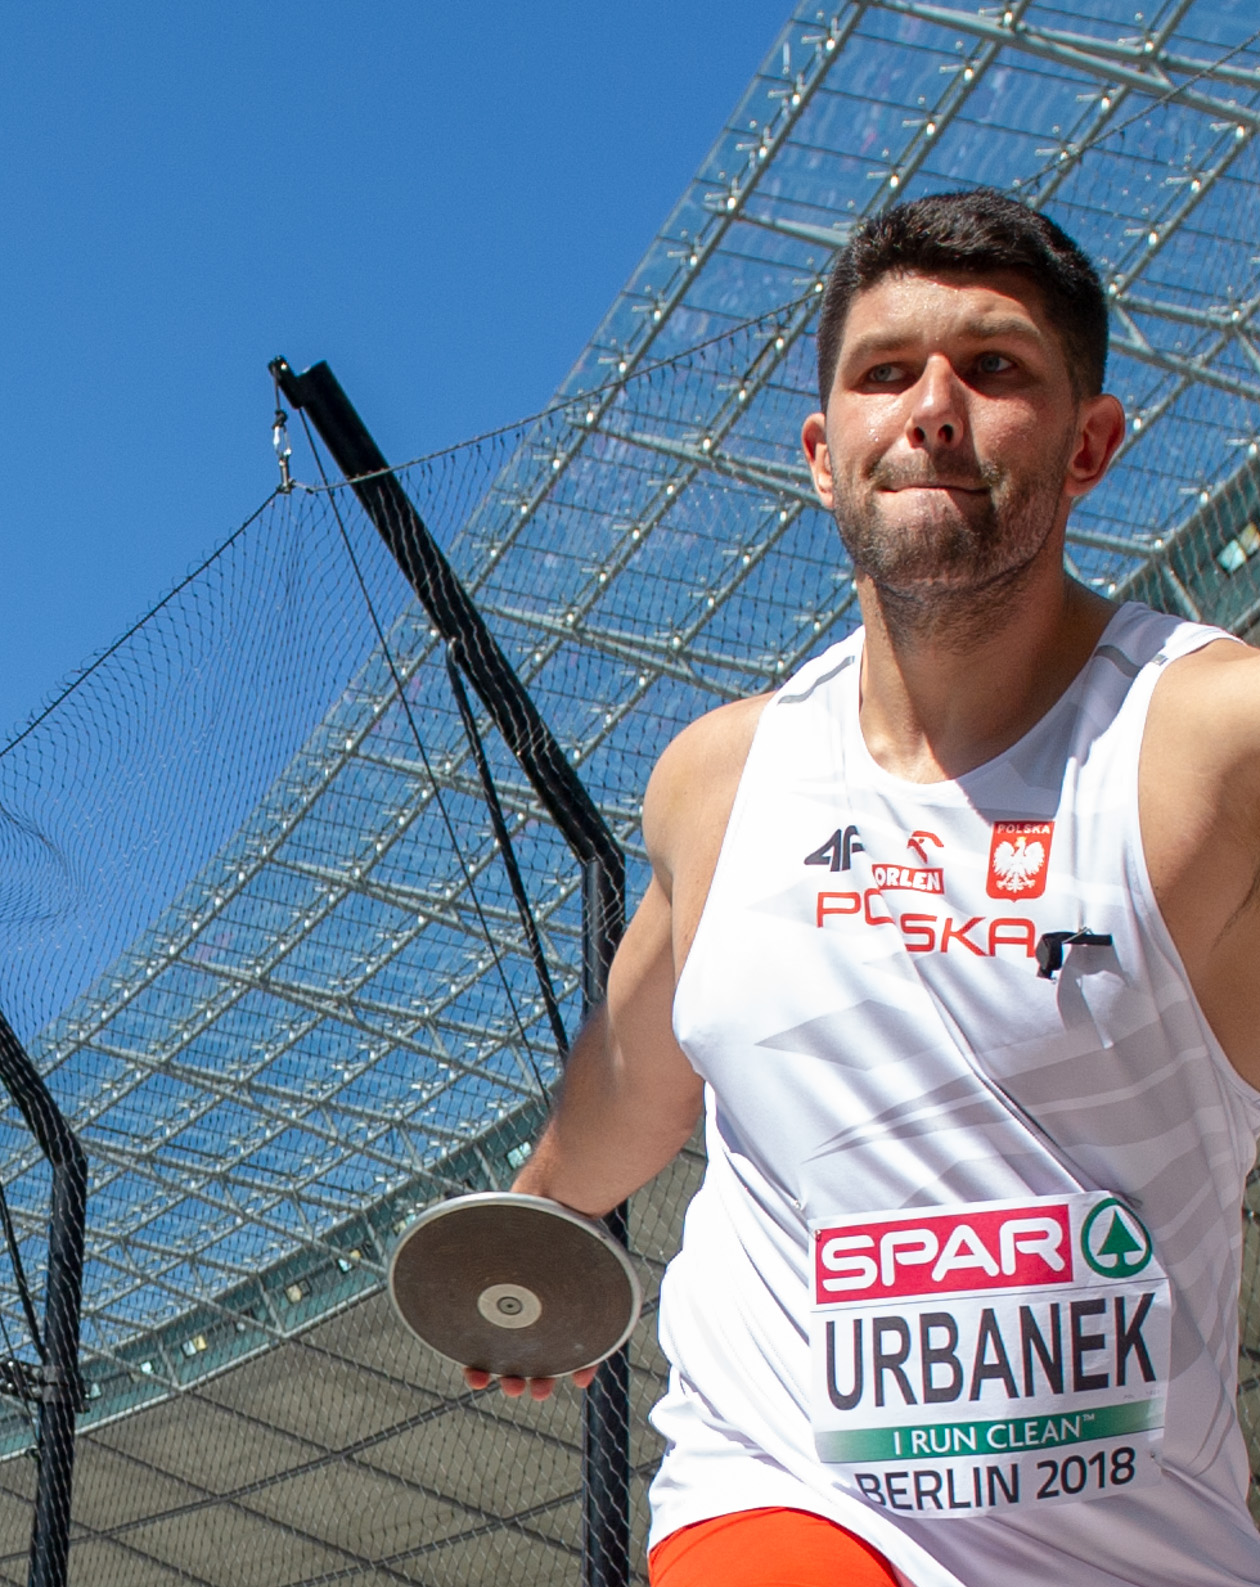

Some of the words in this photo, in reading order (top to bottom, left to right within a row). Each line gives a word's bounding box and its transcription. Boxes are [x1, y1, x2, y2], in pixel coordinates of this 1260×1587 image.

[997, 823, 1051, 835] POLSKA
[874, 866, 942, 892] ORLEN
[816, 887, 1037, 958] POSKA
[821, 1215, 1065, 1292] SPAR
[824, 1292, 1156, 1411] URBANEK
[894, 1436, 902, 1455] I
[911, 1426, 977, 1455] RUN
[854, 1463, 1020, 1512] BERLIN
[1036, 1446, 1136, 1500] 2018
